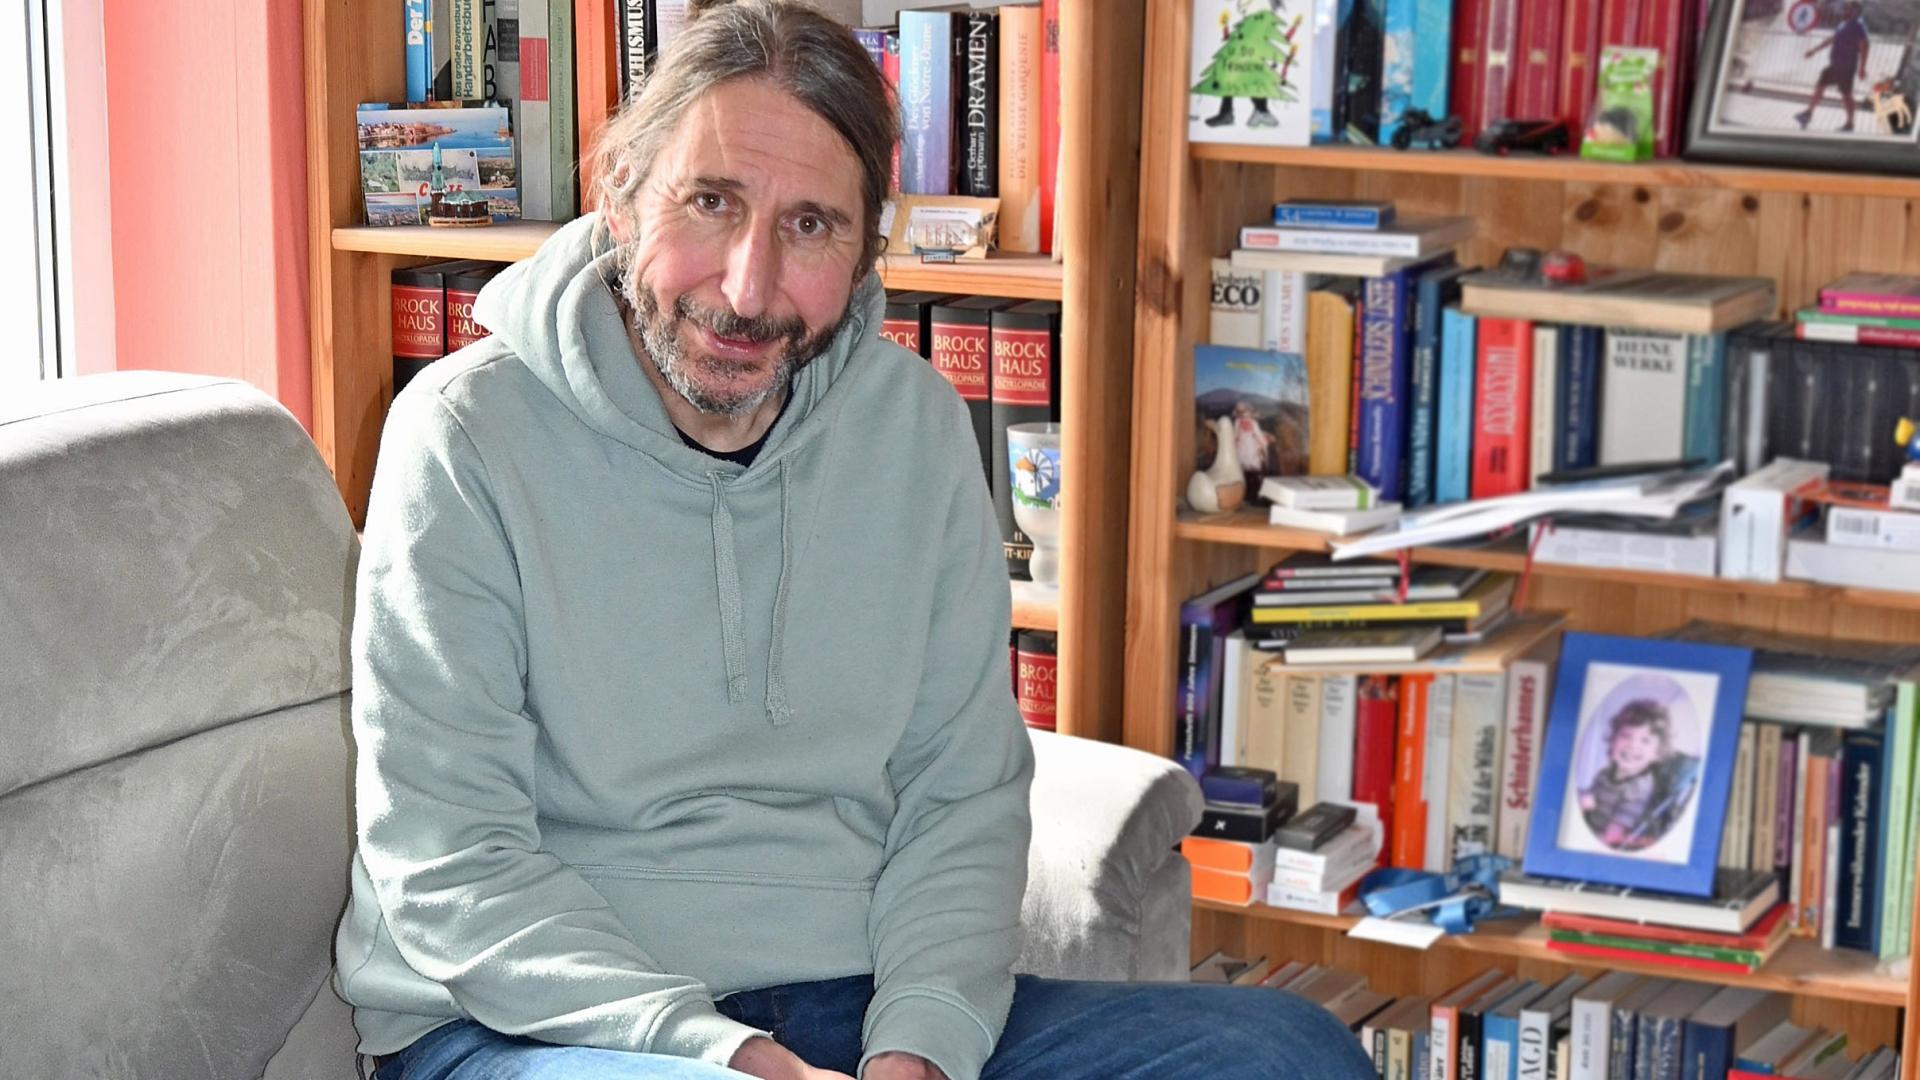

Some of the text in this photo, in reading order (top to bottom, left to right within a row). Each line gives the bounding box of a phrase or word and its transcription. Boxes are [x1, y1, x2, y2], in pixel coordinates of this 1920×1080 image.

[408, 9, 423, 45] Der
[969, 20, 987, 127] DRAMEN
[1017, 32, 1030, 179] DIE WEISSE GARDENIE
[968, 132, 977, 169] Gerhart
[975, 132, 990, 189] Hauptmann
[1210, 283, 1260, 306] ECO
[394, 297, 440, 316] BROCK
[448, 301, 475, 320] BRO
[398, 314, 436, 331] HAUS
[453, 319, 490, 336] HAU
[879, 330, 918, 349] OCK
[933, 334, 986, 353] BROCK
[1615, 339, 1672, 356] HEINE
[994, 341, 1047, 359] BROCK
[939, 353, 982, 371] HAUS
[1000, 359, 1043, 377] HAUS
[1613, 356, 1675, 374] WERKE
[1020, 663, 1057, 683] BROC
[1024, 683, 1057, 701] HAU
[1506, 675, 1535, 810] Schinderhannes
[1853, 763, 1870, 817] Kalender
